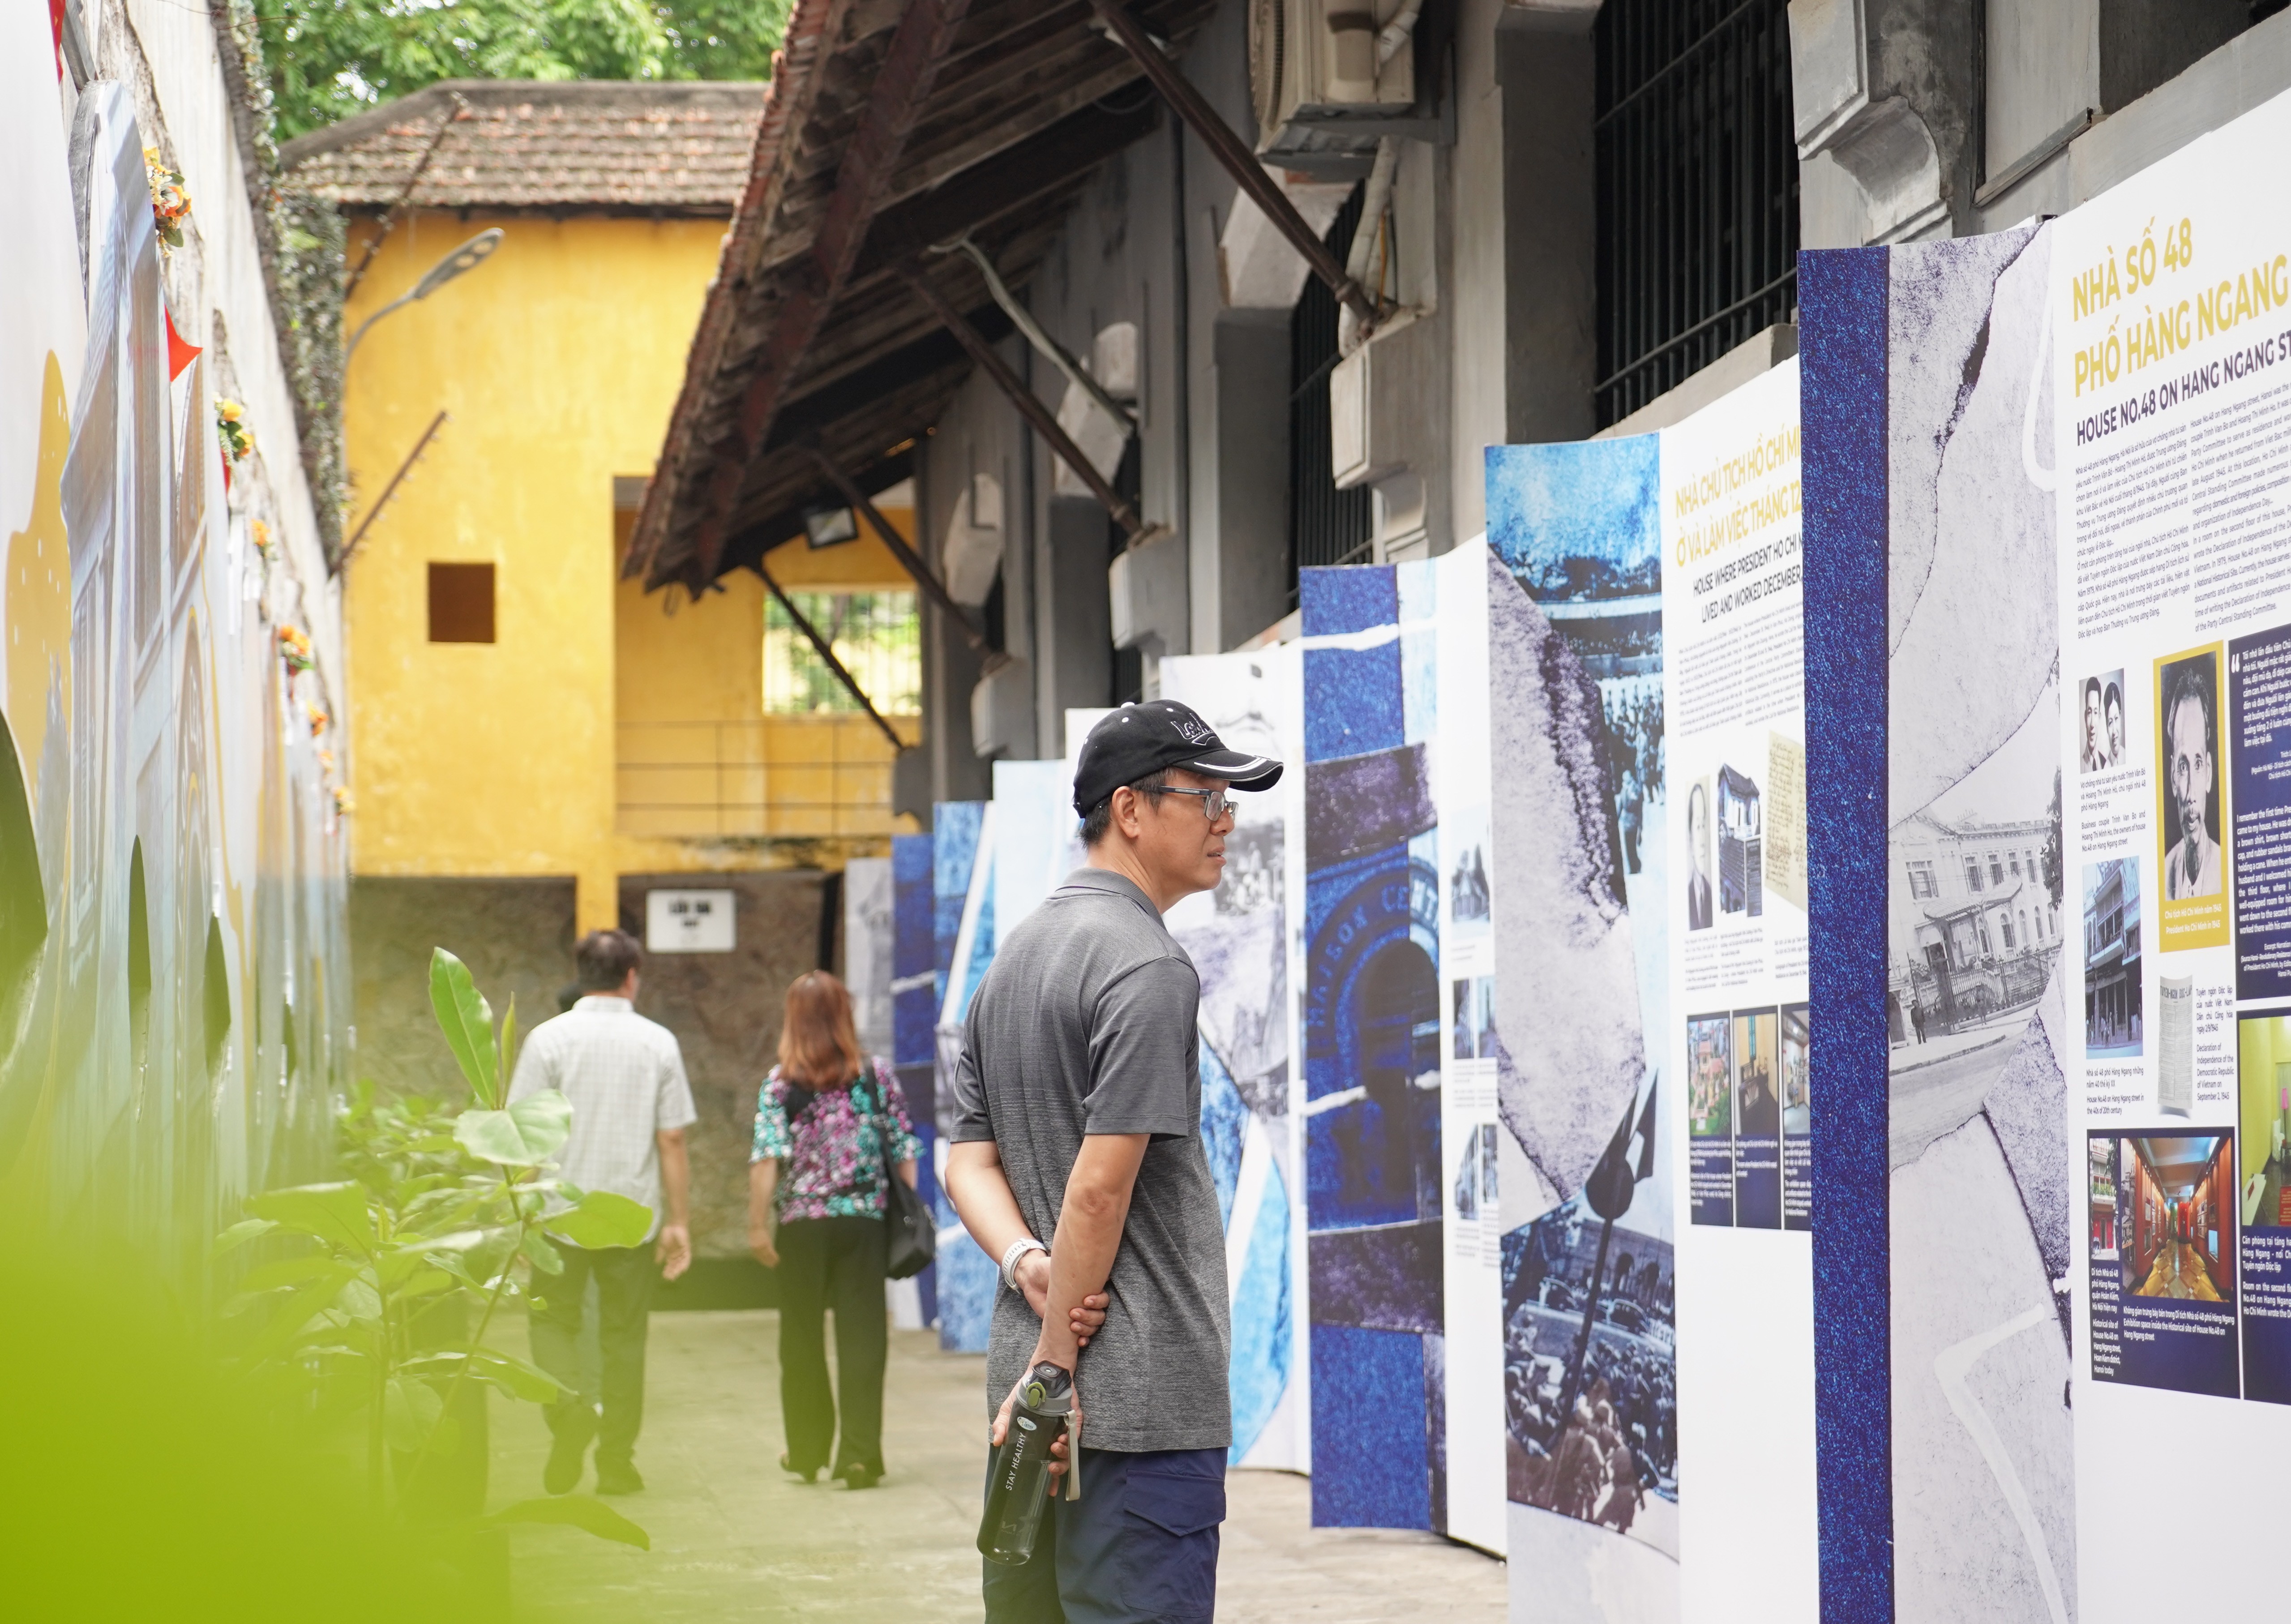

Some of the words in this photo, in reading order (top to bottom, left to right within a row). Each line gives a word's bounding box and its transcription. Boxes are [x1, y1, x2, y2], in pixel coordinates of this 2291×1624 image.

[2074, 245, 2121, 321] NHÀ
[2126, 216, 2156, 294] SỐ
[2163, 218, 2191, 272] 48
[2075, 314, 2120, 398] PHỐ
[2127, 300, 2190, 374] HÀNG
[2197, 254, 2288, 341] NGANG
[2077, 407, 2117, 446] HOUSE
[2121, 390, 2156, 428] NO.48
[2160, 379, 2177, 410] ON
[2182, 361, 2219, 401] HANG
[2224, 339, 2274, 383] NGANG
[1676, 474, 1699, 518] NHÀ
[1700, 457, 1721, 506] CHỦ
[1723, 454, 1745, 500] TỊCH
[1748, 433, 1764, 481] HỒ
[1766, 424, 1784, 471] CHÍ
[1787, 425, 1799, 461] MI
[1677, 526, 1686, 567] Ở
[1688, 521, 1702, 562] VÀ
[1704, 513, 1724, 556] LÀM
[1726, 499, 1749, 547] VIỆC
[1750, 484, 1788, 531] THÁNG
[1693, 573, 1713, 597] HOUSE
[1716, 561, 1736, 586] WHERE
[1738, 545, 1772, 574] PRESIDENT
[1773, 540, 1783, 560] HO
[1785, 534, 1796, 555] CHI
[1702, 601, 1718, 623] LIVED
[1721, 594, 1732, 614] AND
[1735, 581, 1761, 608] WORKED
[2081, 821, 2096, 829] Business
[2098, 818, 2109, 827] couple
[2082, 844, 2092, 852] No.48
[2107, 840, 2117, 849] Ngang
[1382, 879, 1438, 921] CENT
[1006, 1470, 1016, 1491] STAY
[1011, 1432, 1026, 1469] HEALTHY
